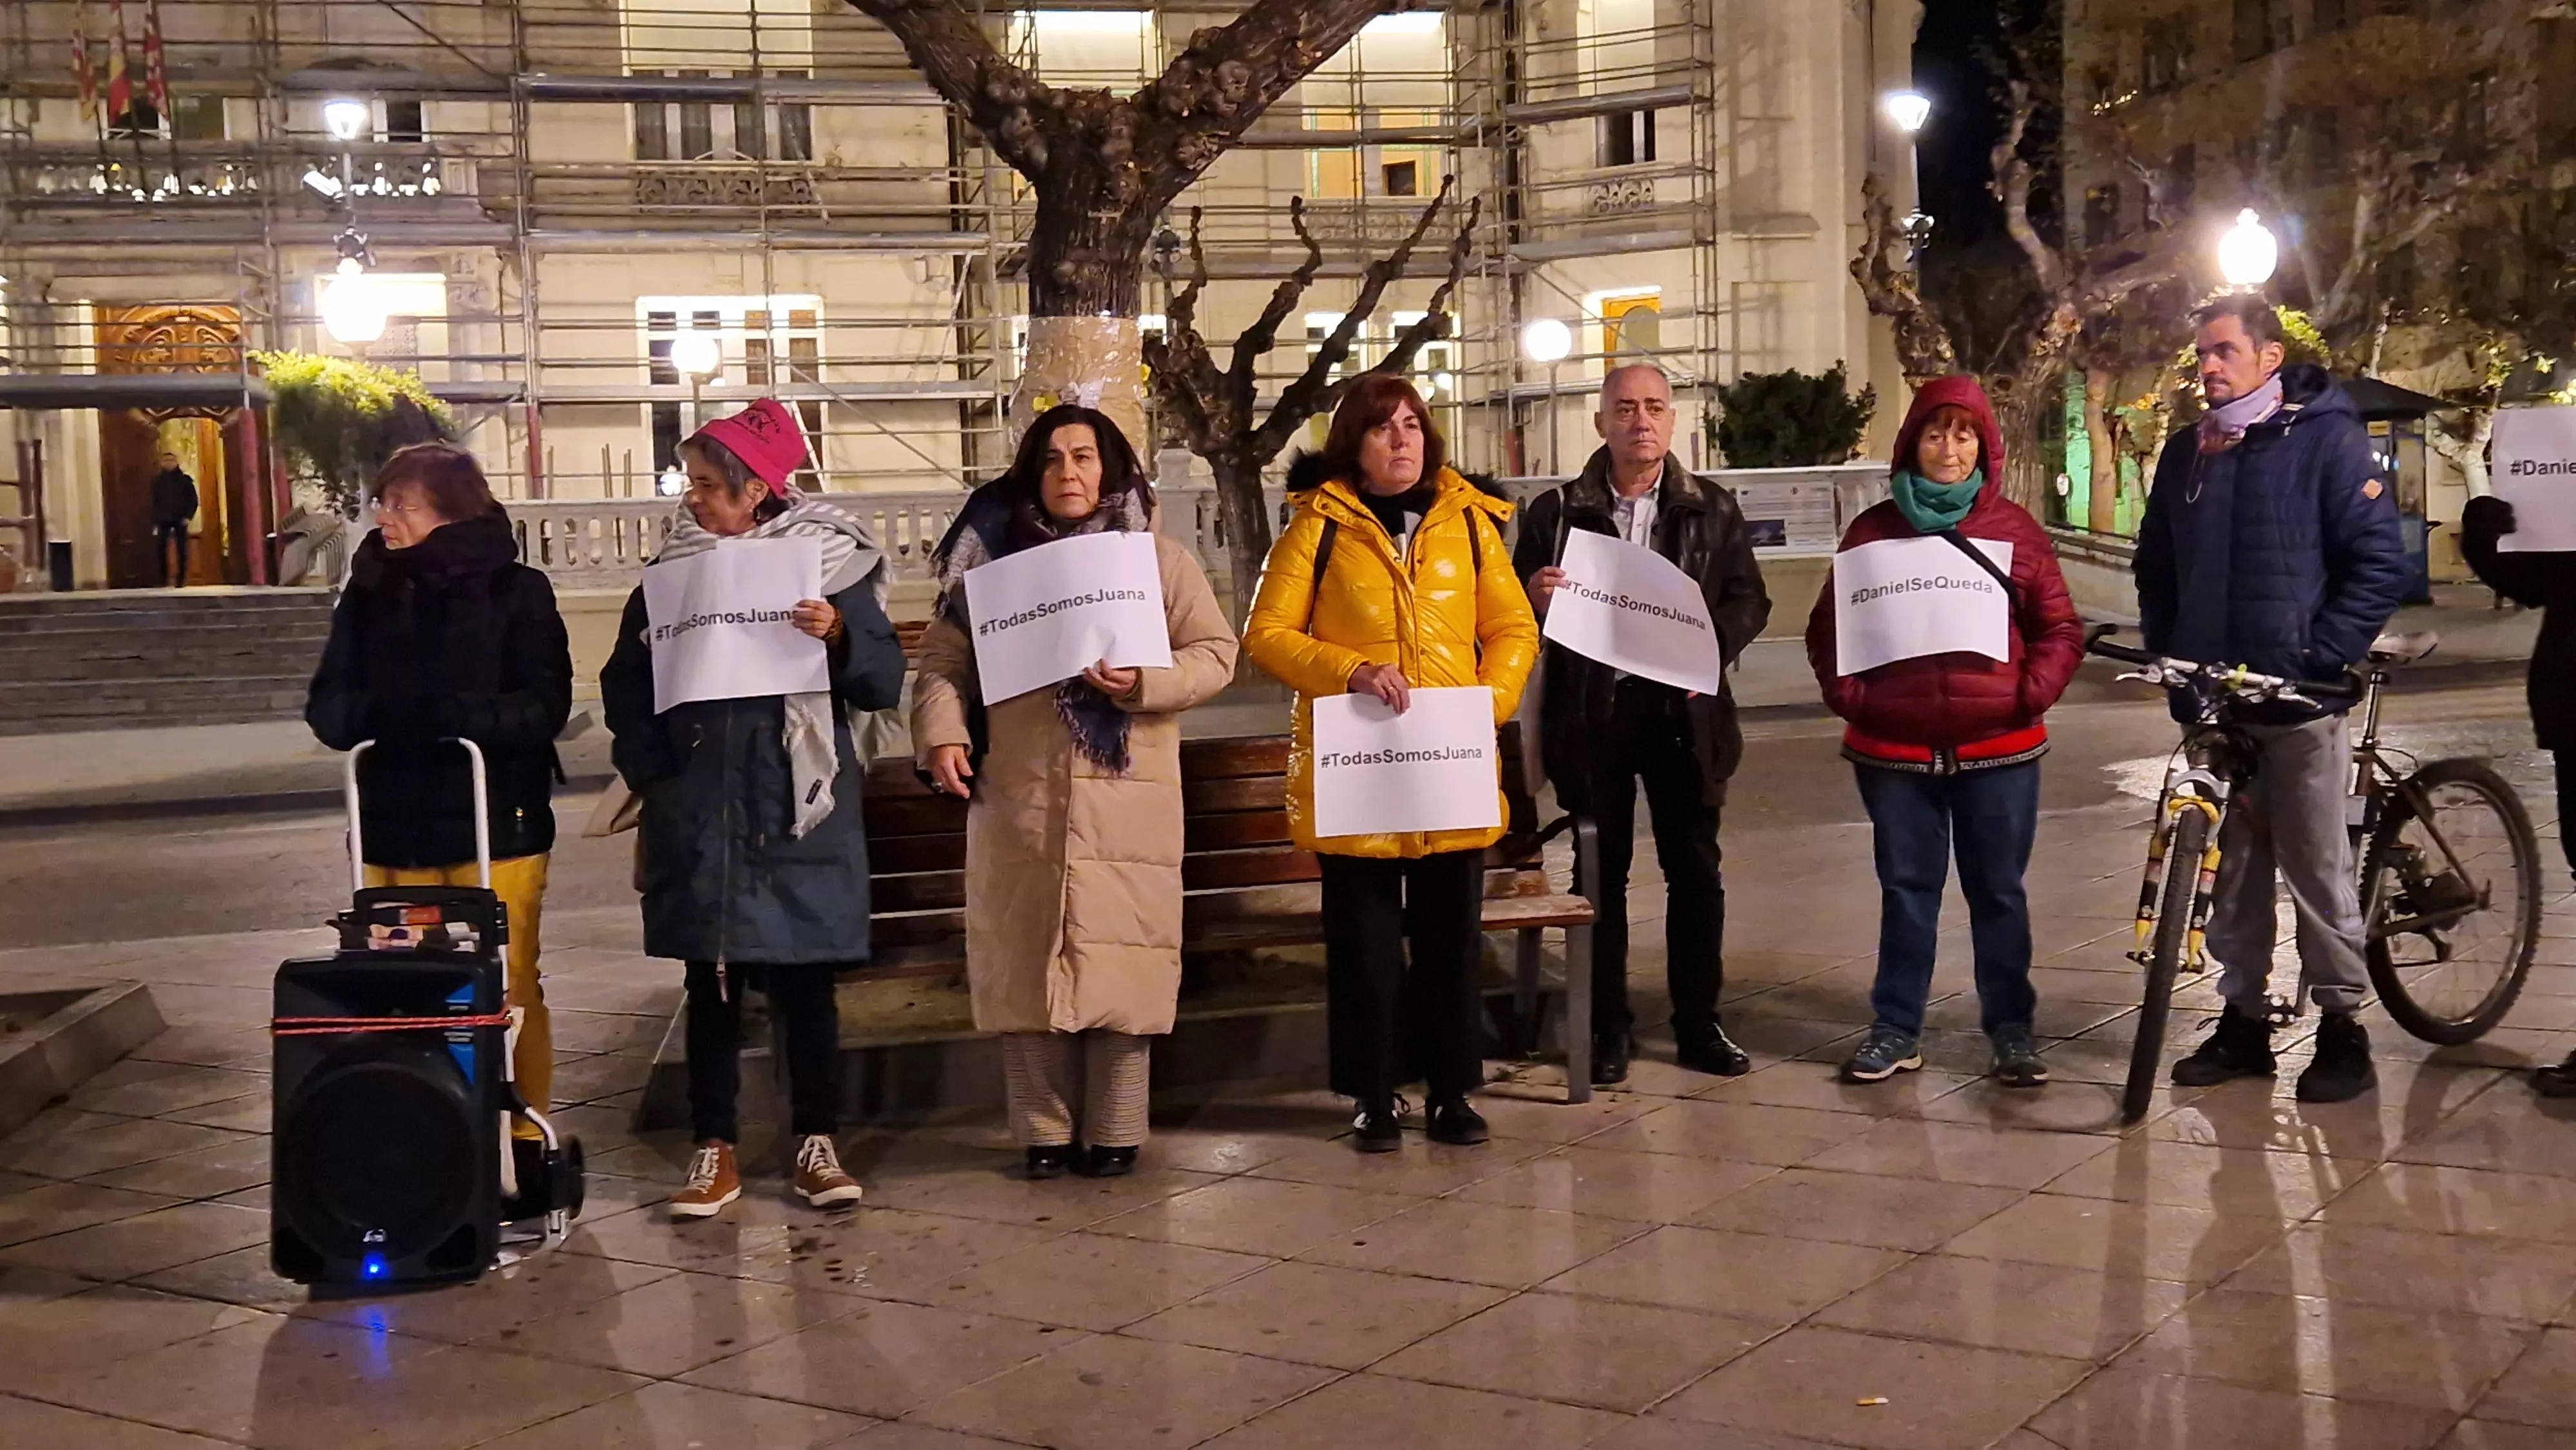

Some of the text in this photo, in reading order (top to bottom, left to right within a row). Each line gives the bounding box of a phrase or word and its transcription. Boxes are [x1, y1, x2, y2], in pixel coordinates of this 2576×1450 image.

[2510, 459, 2576, 476] #Danie
[1851, 576, 1993, 606] #DanielSeQueda
[655, 608, 799, 641] #ToSomosJuan
[980, 588, 1145, 636] #TodasSomosJuana
[1321, 746, 1482, 768] #TodasSomosJuana
